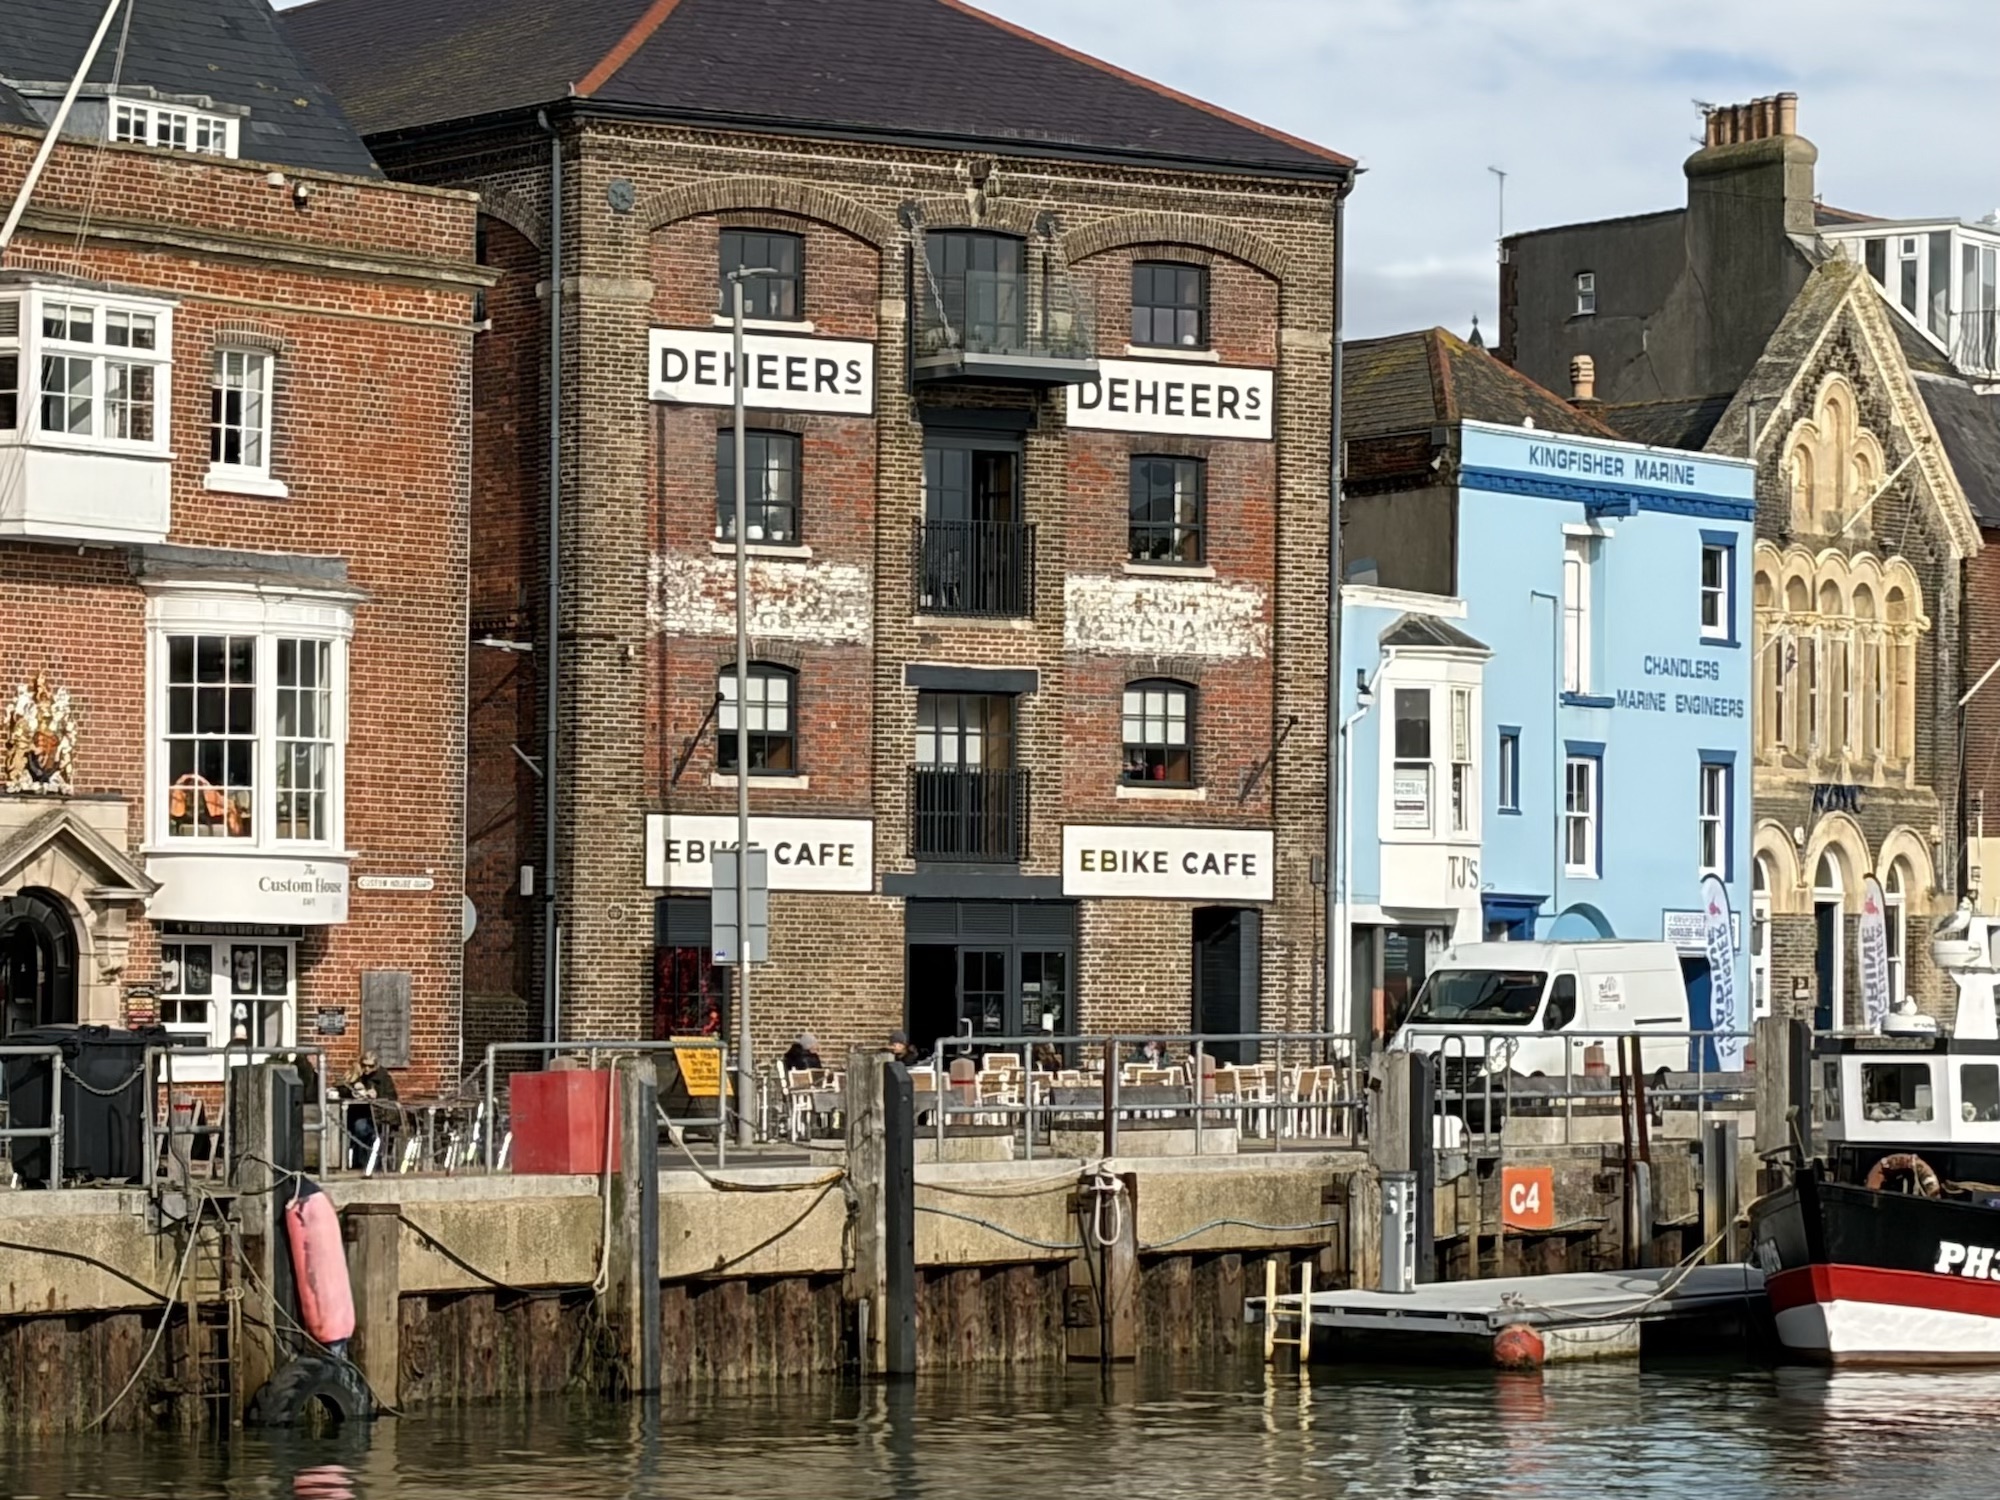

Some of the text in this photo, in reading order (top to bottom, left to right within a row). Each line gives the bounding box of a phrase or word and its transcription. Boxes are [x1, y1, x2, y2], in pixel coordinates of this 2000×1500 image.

[1529, 445, 1695, 485] KINGFISHER MARINE
[1644, 655, 1719, 680] CHANDLERS
[1617, 689, 1743, 718] MARINE ENGINEERS
[665, 839, 854, 867] EBI CAFE
[1080, 849, 1256, 876] EBIKE CAFE
[259, 877, 312, 892] Custom
[1448, 856, 1478, 889] TJ'S
[1510, 1182, 1540, 1214] C4
